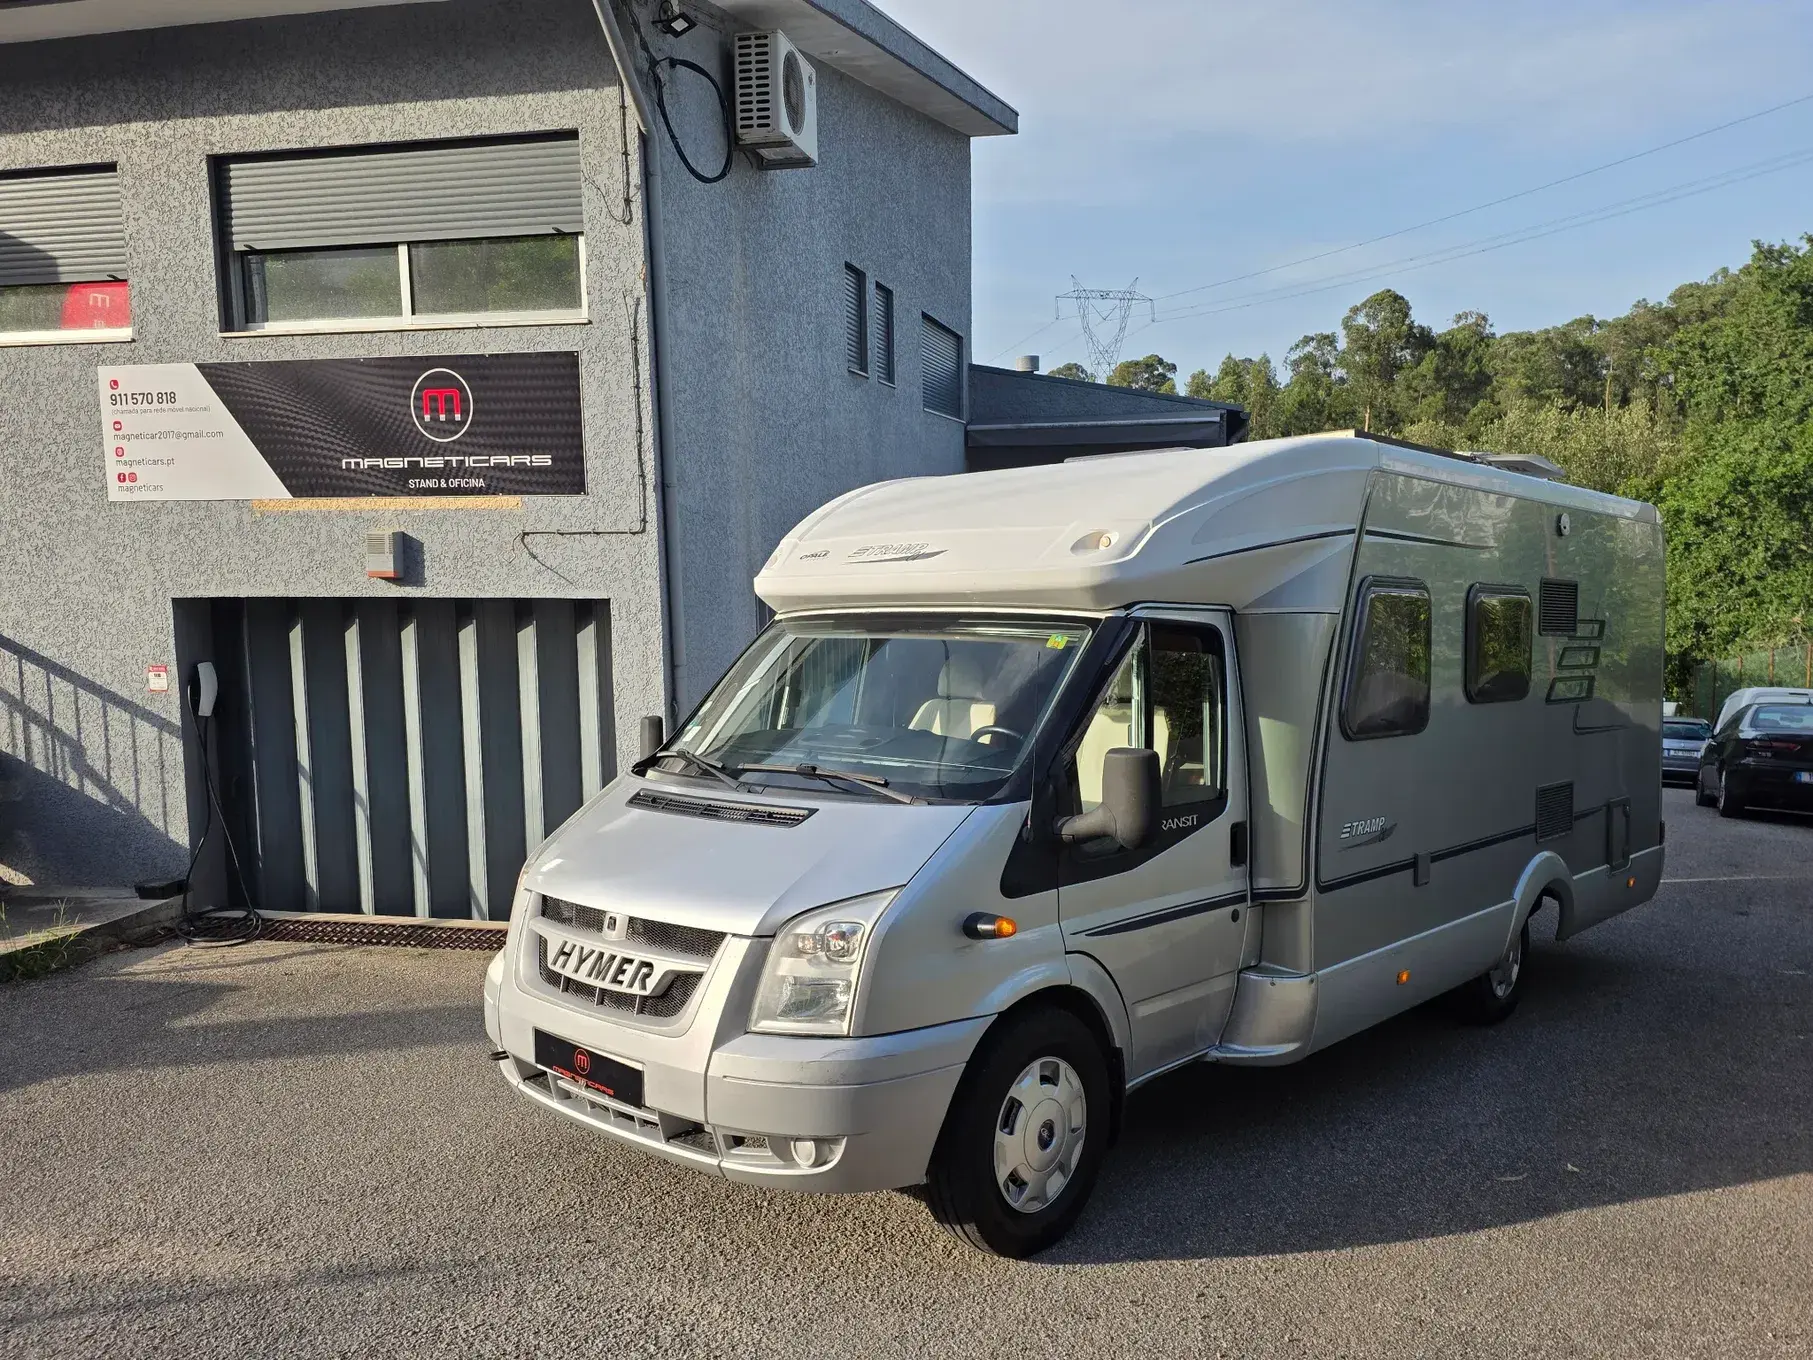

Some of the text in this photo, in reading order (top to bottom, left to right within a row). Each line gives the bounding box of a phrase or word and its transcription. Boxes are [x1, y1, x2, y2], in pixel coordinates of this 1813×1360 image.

[110, 391, 177, 406] 911 570 818
[111, 407, 138, 415] (chamada
[185, 405, 211, 413] nacional)
[113, 430, 224, 442] magneticar2017@gmail.com
[115, 456, 175, 468] magneticars.pt
[118, 483, 164, 494] magneticars
[408, 478, 485, 488] STAND & OFICINA
[1161, 814, 1199, 831] RANSIT
[550, 940, 655, 992] HYMER
